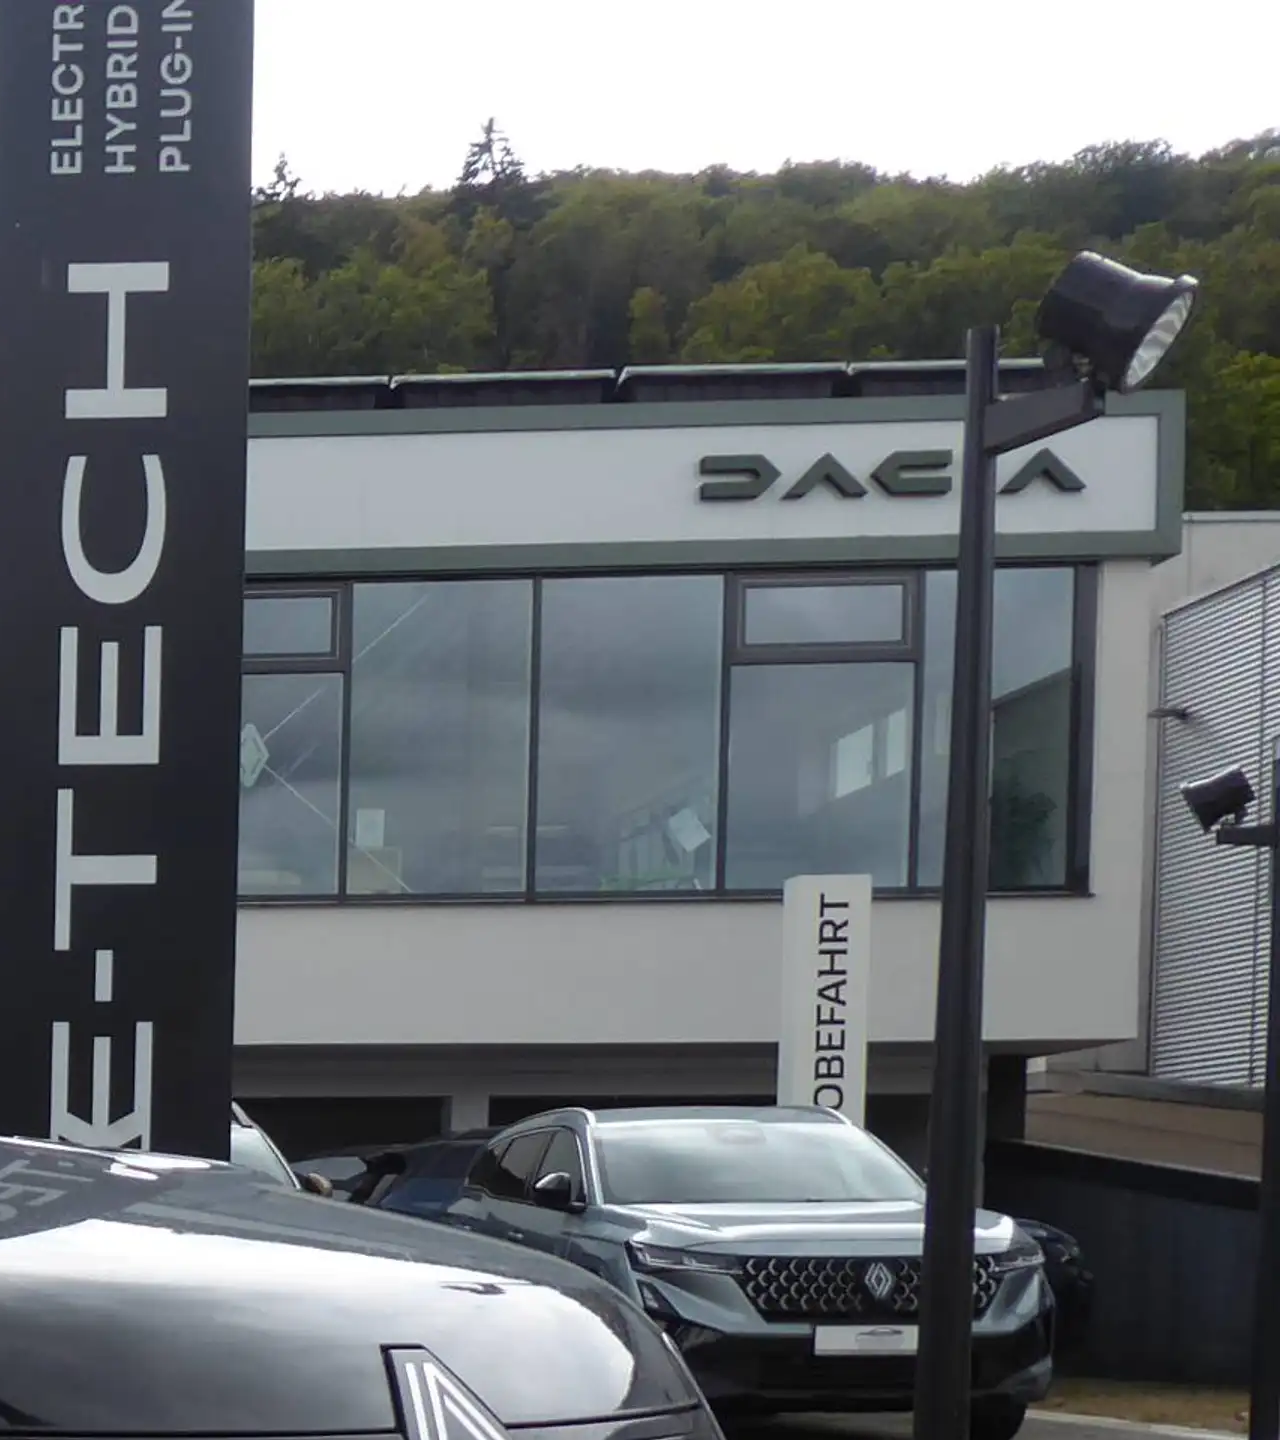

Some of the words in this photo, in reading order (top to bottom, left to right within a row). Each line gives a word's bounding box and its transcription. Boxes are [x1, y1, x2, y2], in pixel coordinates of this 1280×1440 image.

[104, 4, 139, 173] HYBRID
[159, 0, 193, 172] PLUG-IN
[698, 447, 1087, 502] DACA
[49, 261, 170, 1152] E-TECH
